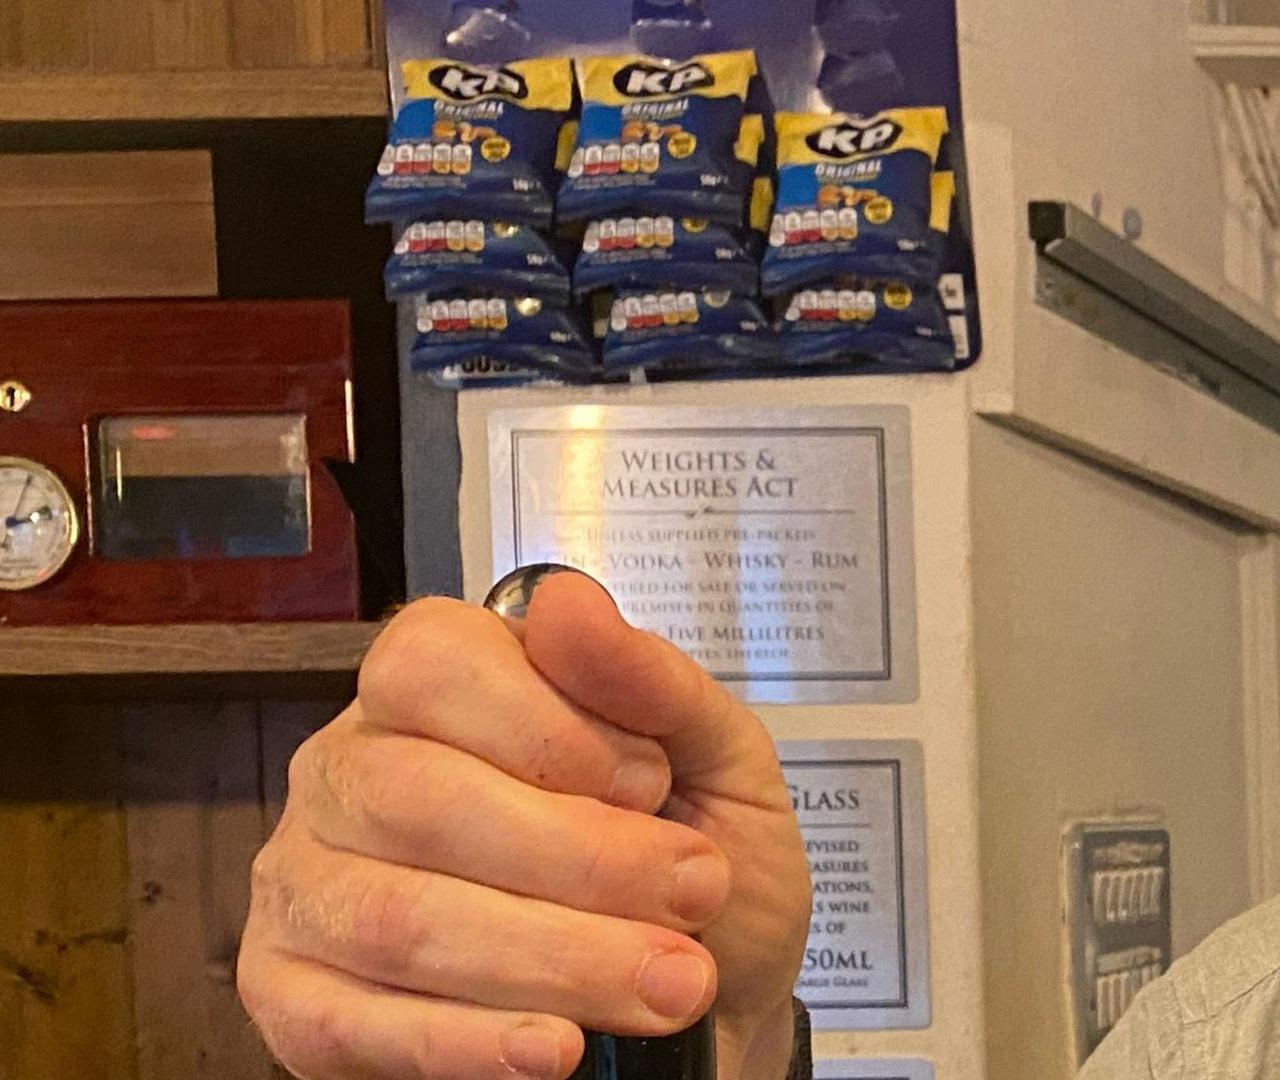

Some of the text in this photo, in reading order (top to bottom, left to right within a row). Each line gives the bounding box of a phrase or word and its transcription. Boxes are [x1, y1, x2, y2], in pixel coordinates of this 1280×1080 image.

[626, 65, 707, 93] KP
[621, 98, 689, 115] ORIGINAL
[818, 123, 894, 153] KP
[815, 158, 882, 177] ORIGINAL
[621, 447, 775, 473] WEIGHTS &
[602, 476, 798, 498] MEASURES ACT
[608, 552, 683, 570] VODKA
[704, 550, 789, 570] WHISKY
[810, 550, 859, 570] RUM
[664, 581, 693, 595] FOR
[697, 600, 714, 613] IN
[669, 624, 825, 641] FIVE MILLILITRES
[805, 839, 860, 853] EVISED
[812, 859, 870, 873] ASURES
[828, 900, 871, 914] WINE
[825, 921, 847, 934] OF
[805, 947, 874, 971] 50ML
